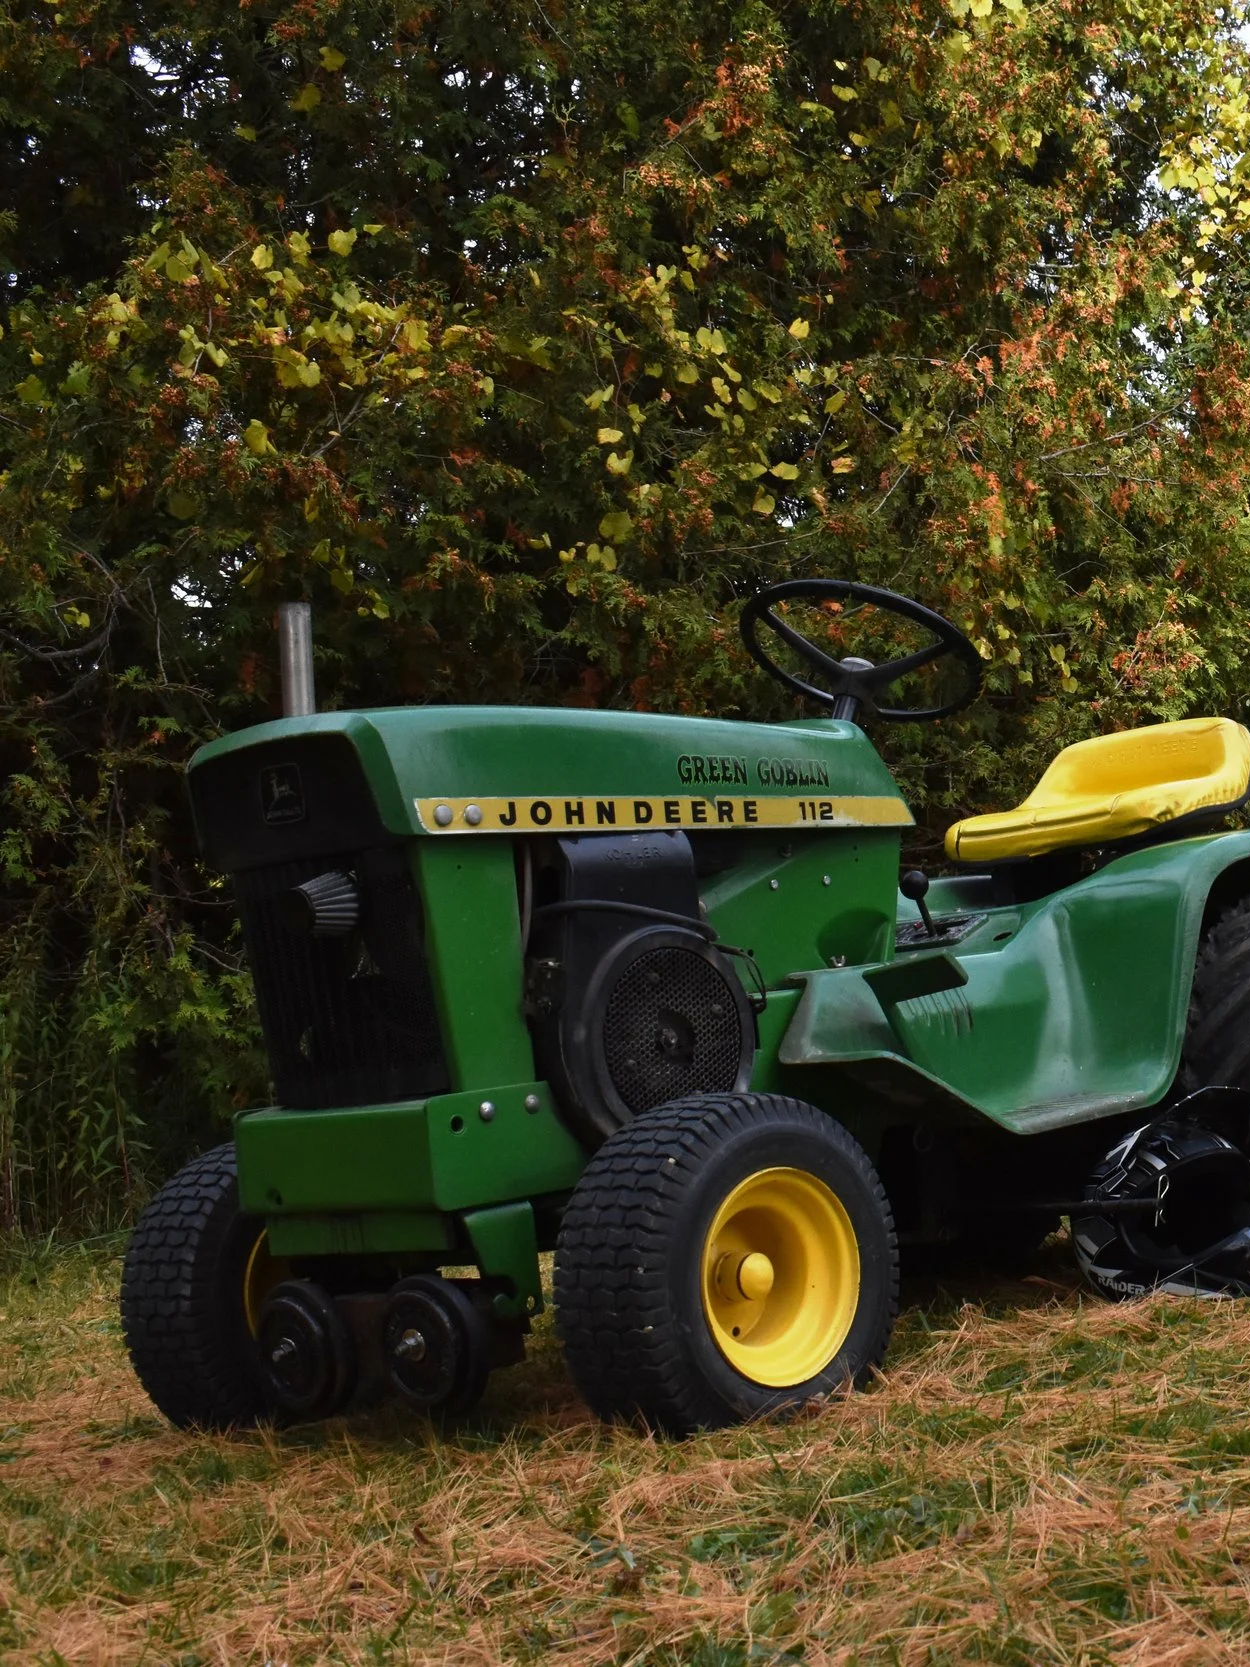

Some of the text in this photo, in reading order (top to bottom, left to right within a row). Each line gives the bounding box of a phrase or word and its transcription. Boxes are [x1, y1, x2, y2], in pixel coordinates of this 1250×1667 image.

[677, 754, 830, 789] GREEN GOBLIN
[499, 800, 834, 826] JOHN DEERE 112
[604, 846, 663, 862] KOHLER
[1098, 1276, 1146, 1295] RAIDER
